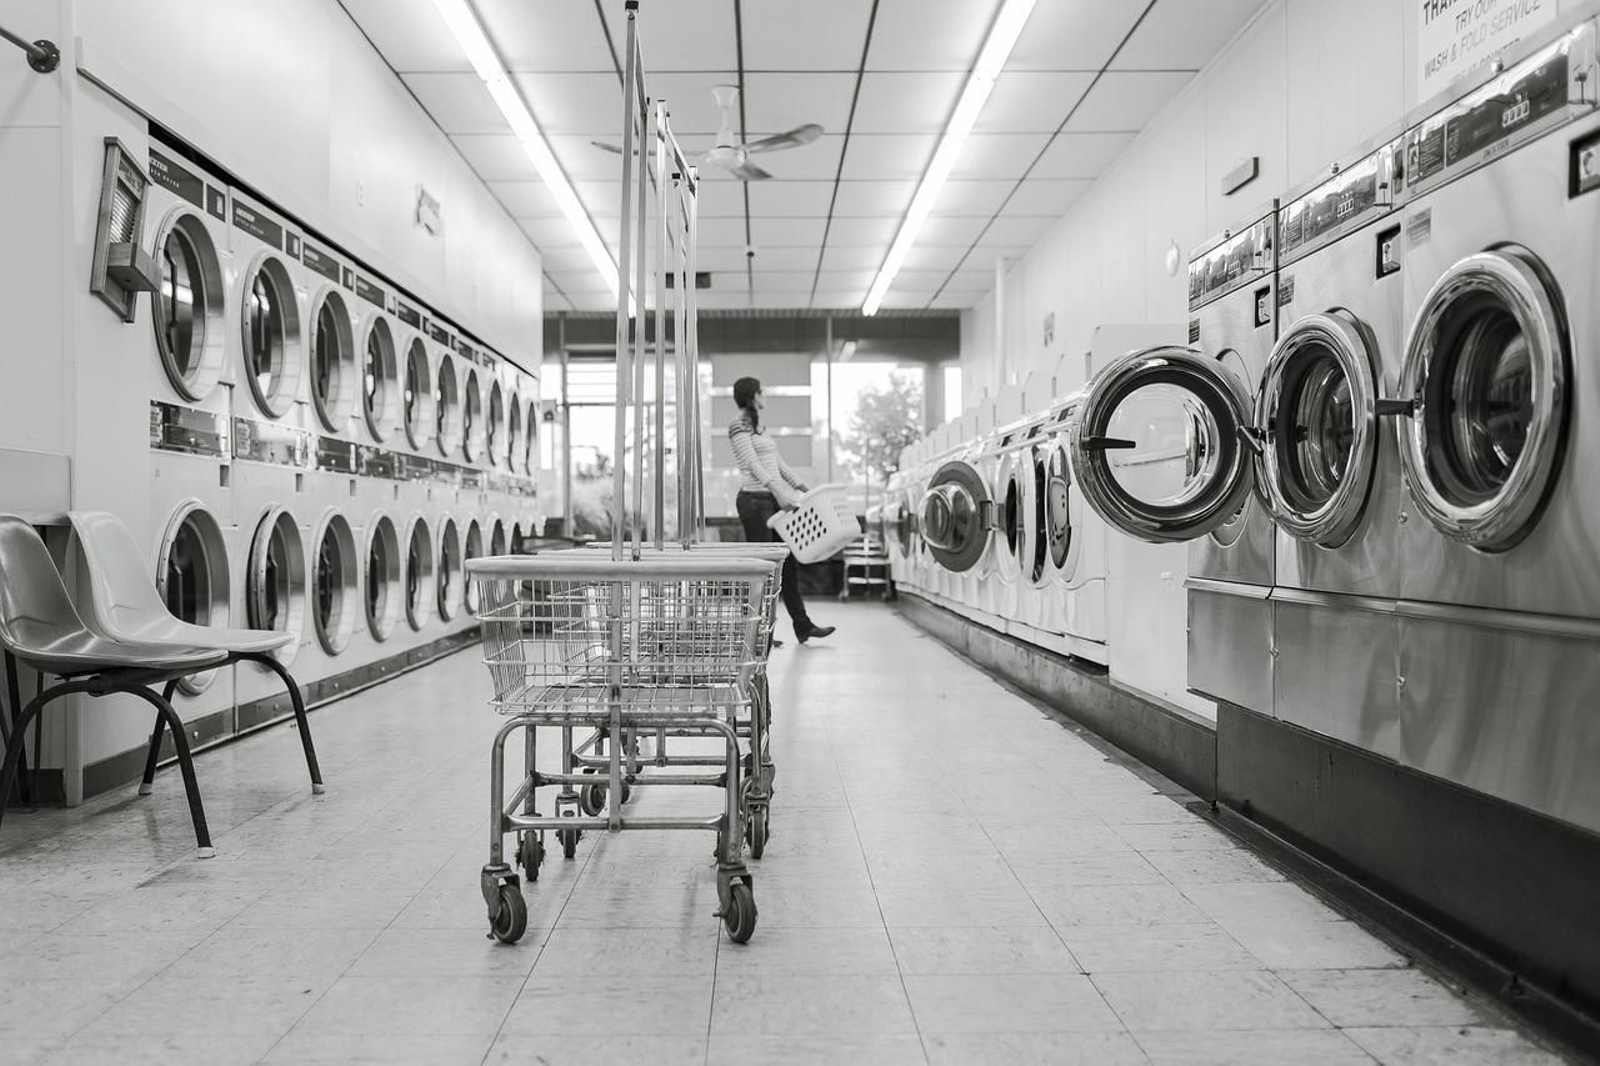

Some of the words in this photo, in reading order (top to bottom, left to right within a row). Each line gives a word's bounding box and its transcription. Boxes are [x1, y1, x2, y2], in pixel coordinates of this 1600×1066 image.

[1424, 47, 1448, 80] WASH
[1450, 43, 1457, 62] &
[1460, 23, 1487, 57] FOLD
[1490, 0, 1541, 36] SERVICE
[1456, 4, 1474, 33] TRY
